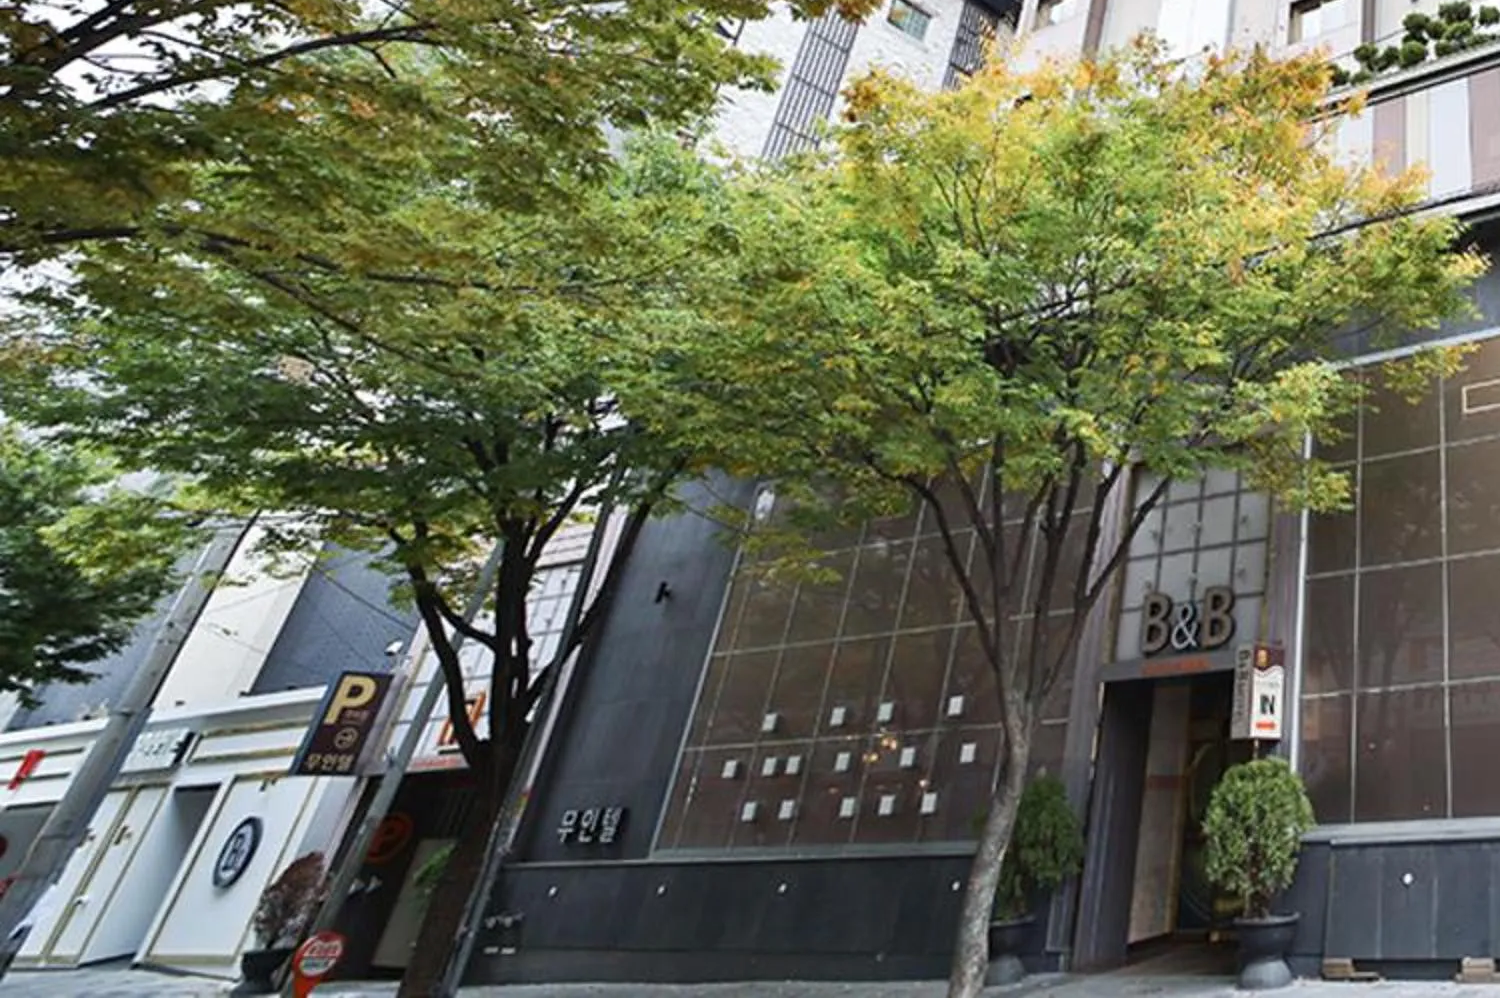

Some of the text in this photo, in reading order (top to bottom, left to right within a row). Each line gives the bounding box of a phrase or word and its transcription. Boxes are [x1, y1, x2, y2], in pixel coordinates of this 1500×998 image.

[1143, 586, 1235, 653] B&B
[323, 674, 377, 724] P
[557, 806, 623, 844] 무인텔
